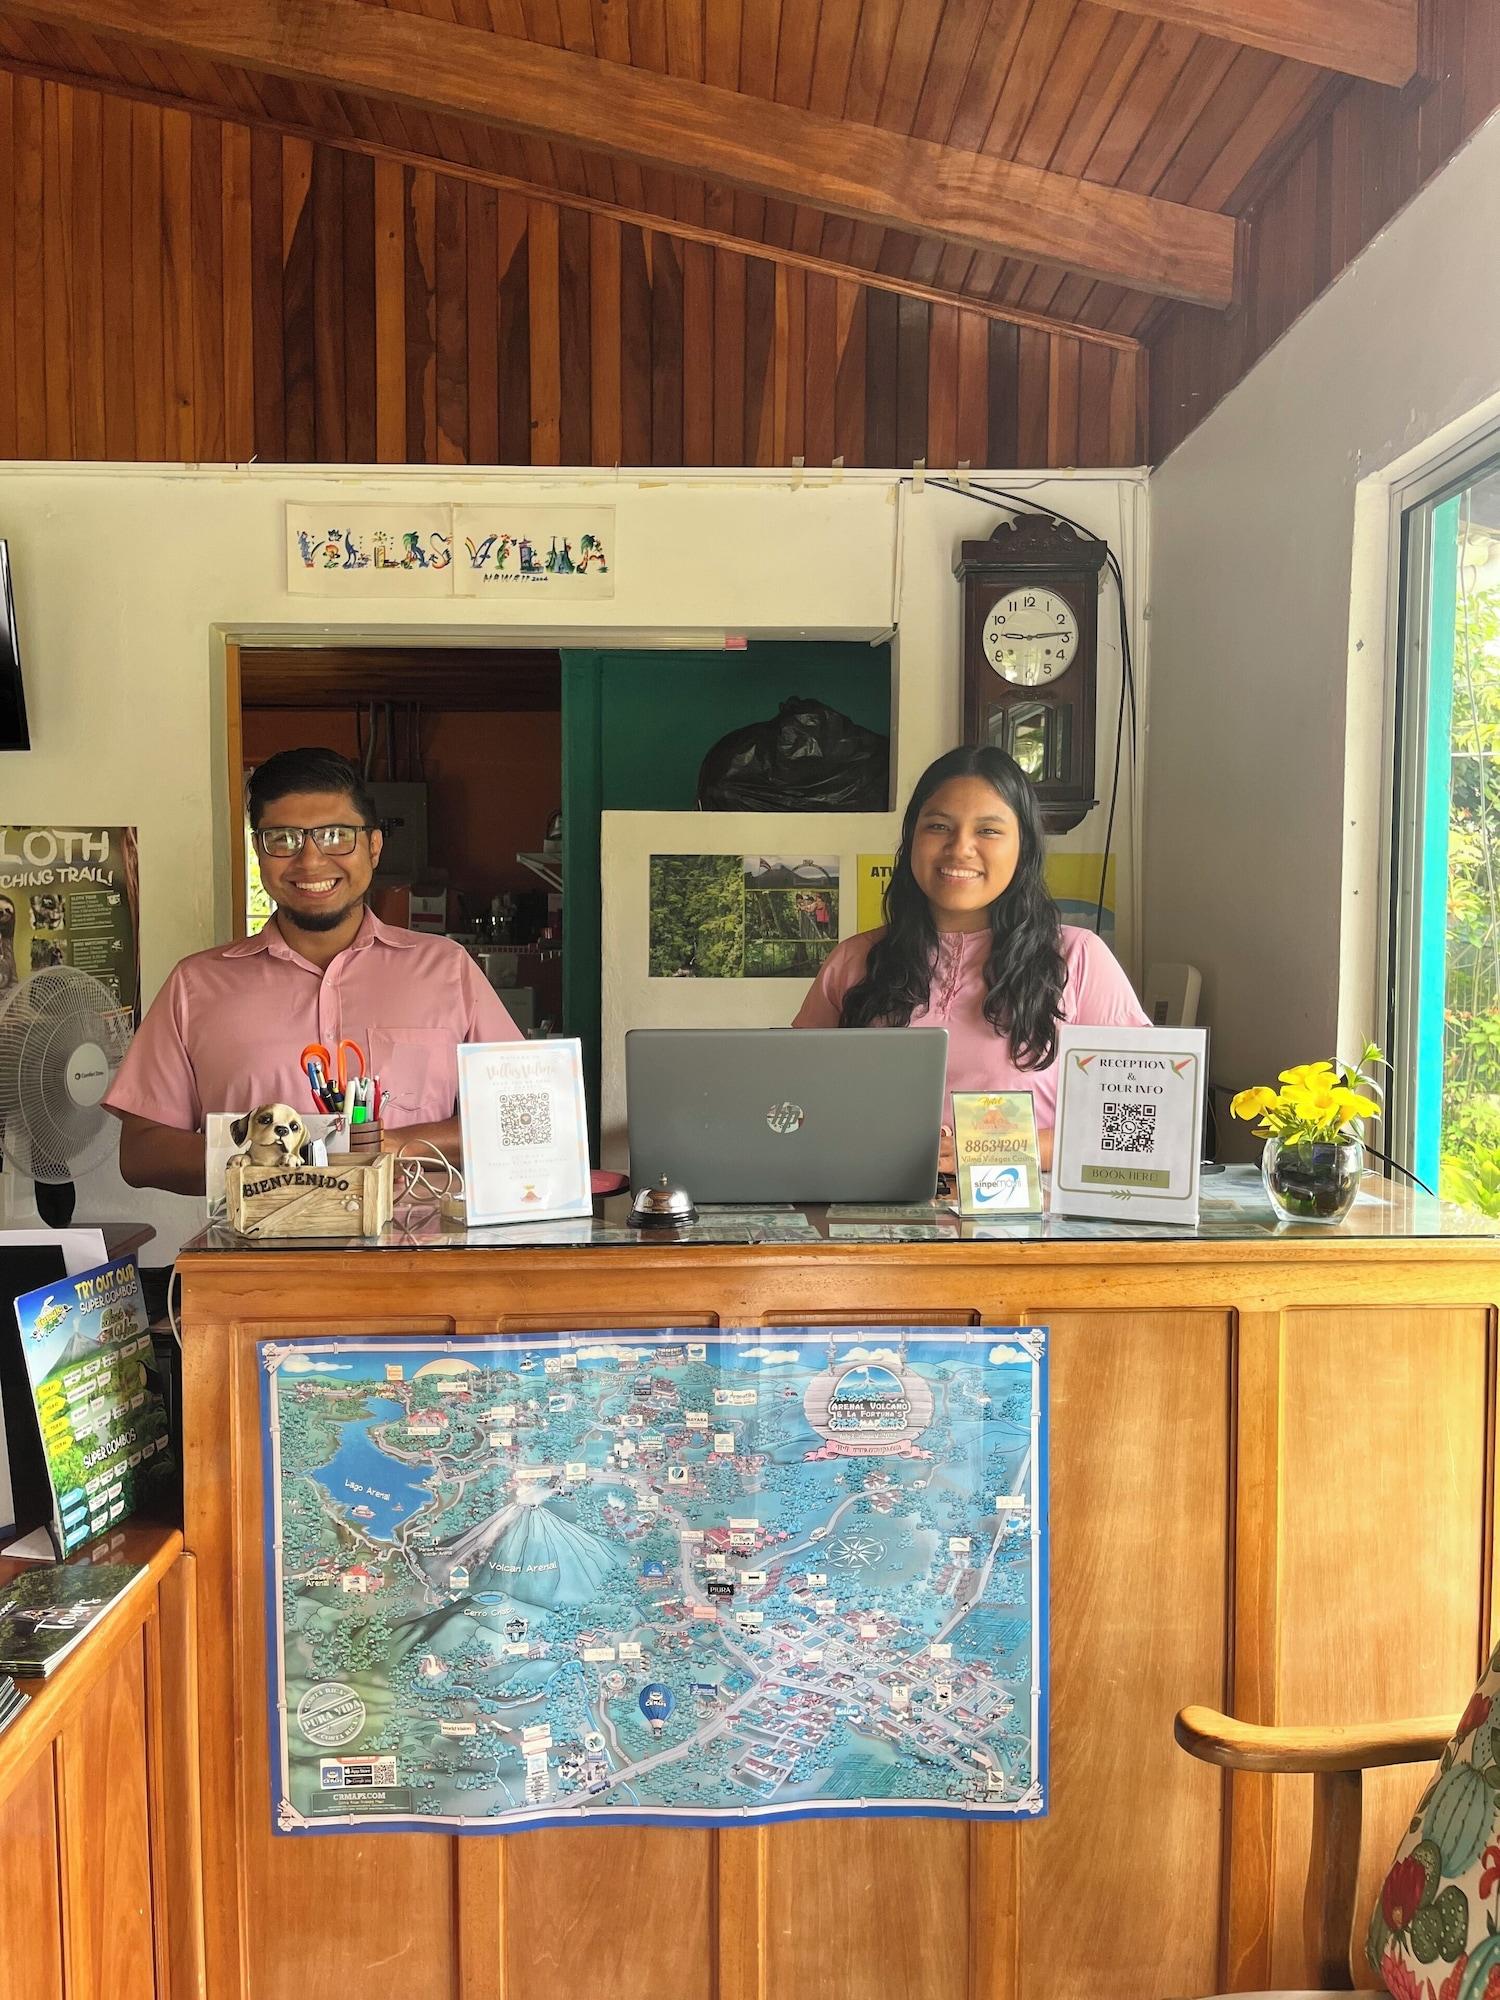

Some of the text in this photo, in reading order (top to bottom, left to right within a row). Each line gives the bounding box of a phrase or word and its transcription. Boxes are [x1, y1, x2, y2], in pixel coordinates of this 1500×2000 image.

[1009, 602, 1017, 611] 11
[1024, 597, 1035, 607] 12
[995, 616, 1006, 625] 10
[1056, 614, 1065, 624] 2
[990, 633, 999, 644] 9
[1061, 633, 1070, 643] 3
[995, 650, 1003, 662] 8
[1056, 650, 1065, 660] 4
[1043, 664, 1051, 674] 5
[1100, 1059, 1166, 1069] RECEPTION
[1127, 1073, 1136, 1081] &
[1100, 1083, 1163, 1095] TOUR INFO
[771, 1102, 800, 1133] hp
[965, 1139, 1028, 1153] 88634204
[1092, 1168, 1125, 1180] BOOK
[243, 1172, 350, 1198] BIENVENIDO
[74, 1263, 135, 1300] TRY OUT OUR
[80, 1281, 138, 1315] SUPER COMBOS
[832, 1402, 907, 1410] ARENAL VOLCANO
[83, 1427, 137, 1470] SUPER COMBOS
[345, 1479, 391, 1501] Lago Arenal
[526, 1560, 558, 1573] Arenal
[33, 1597, 101, 1634] Tours
[464, 1608, 488, 1617] Cerro
[303, 1699, 361, 1731] PURA VIDA
